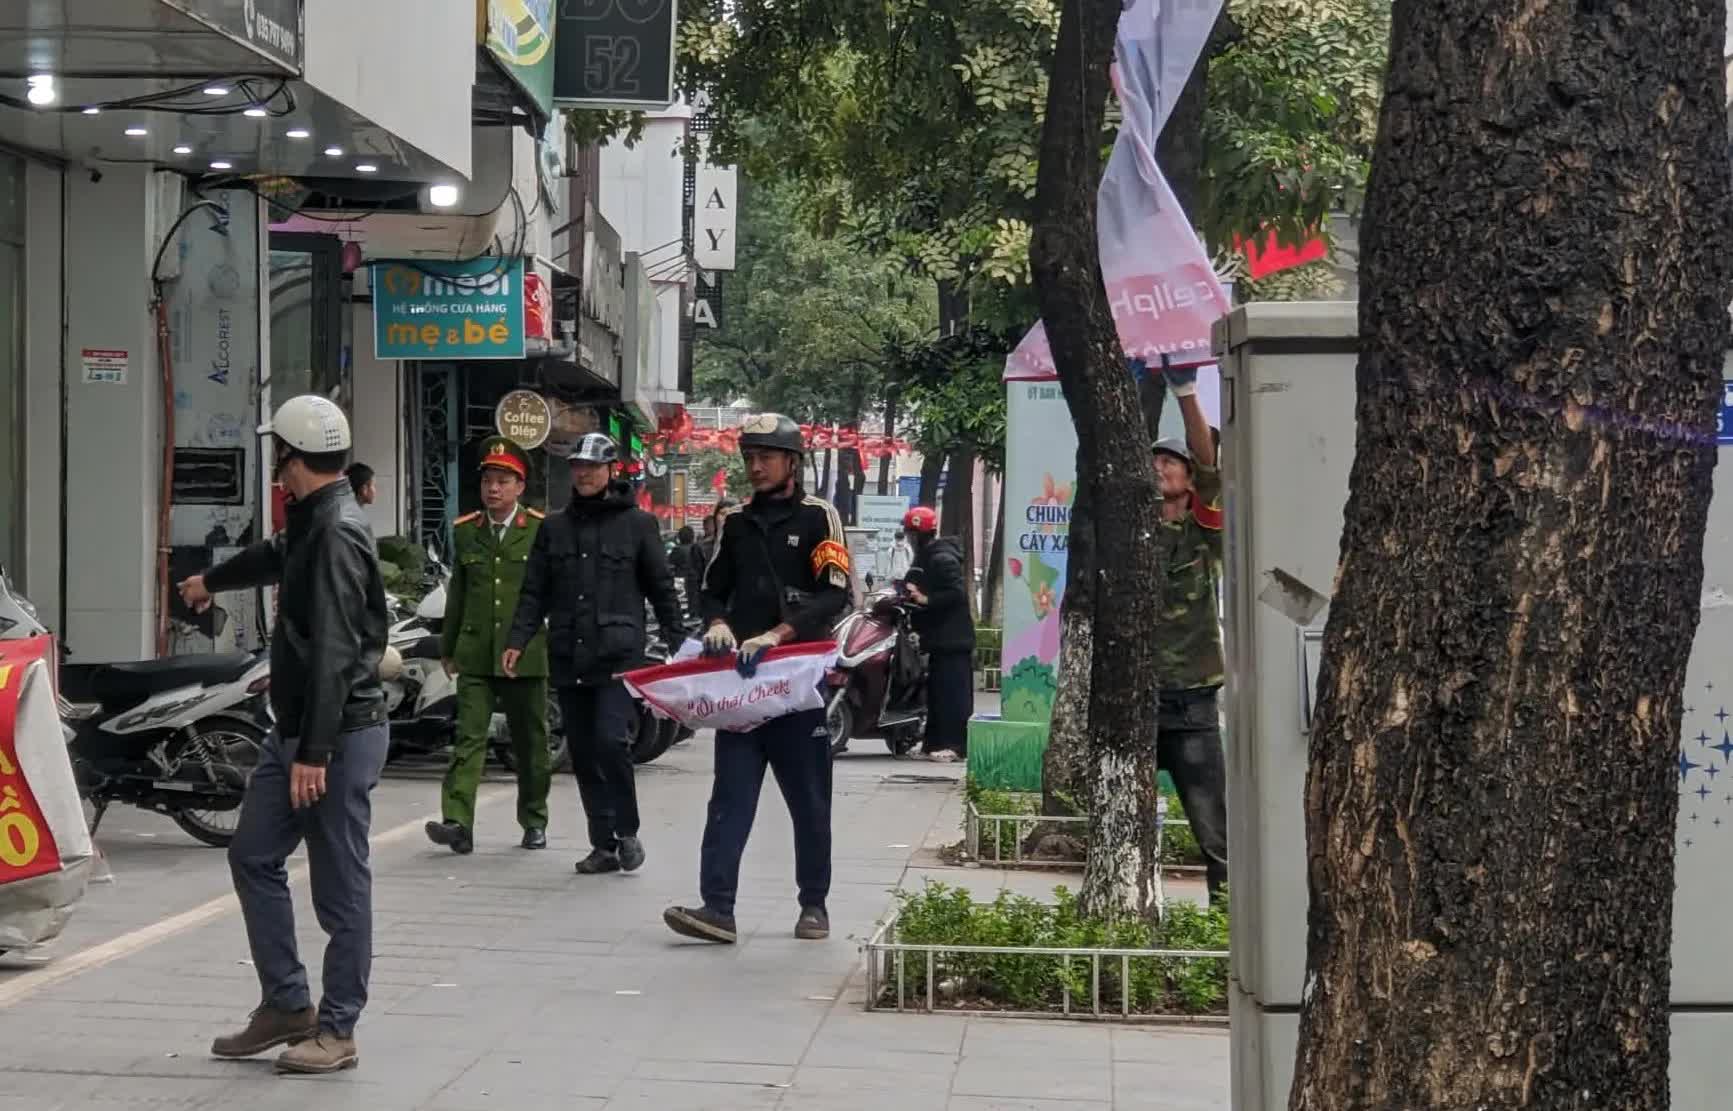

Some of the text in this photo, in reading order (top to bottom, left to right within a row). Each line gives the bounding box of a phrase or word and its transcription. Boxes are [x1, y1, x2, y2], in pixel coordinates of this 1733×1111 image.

[584, 35, 640, 94] 52
[476, 301, 507, 313] HÀNG
[447, 329, 460, 345] &
[464, 316, 509, 345] bé
[504, 411, 545, 423] Coffee
[1020, 530, 1047, 551] CÂY
